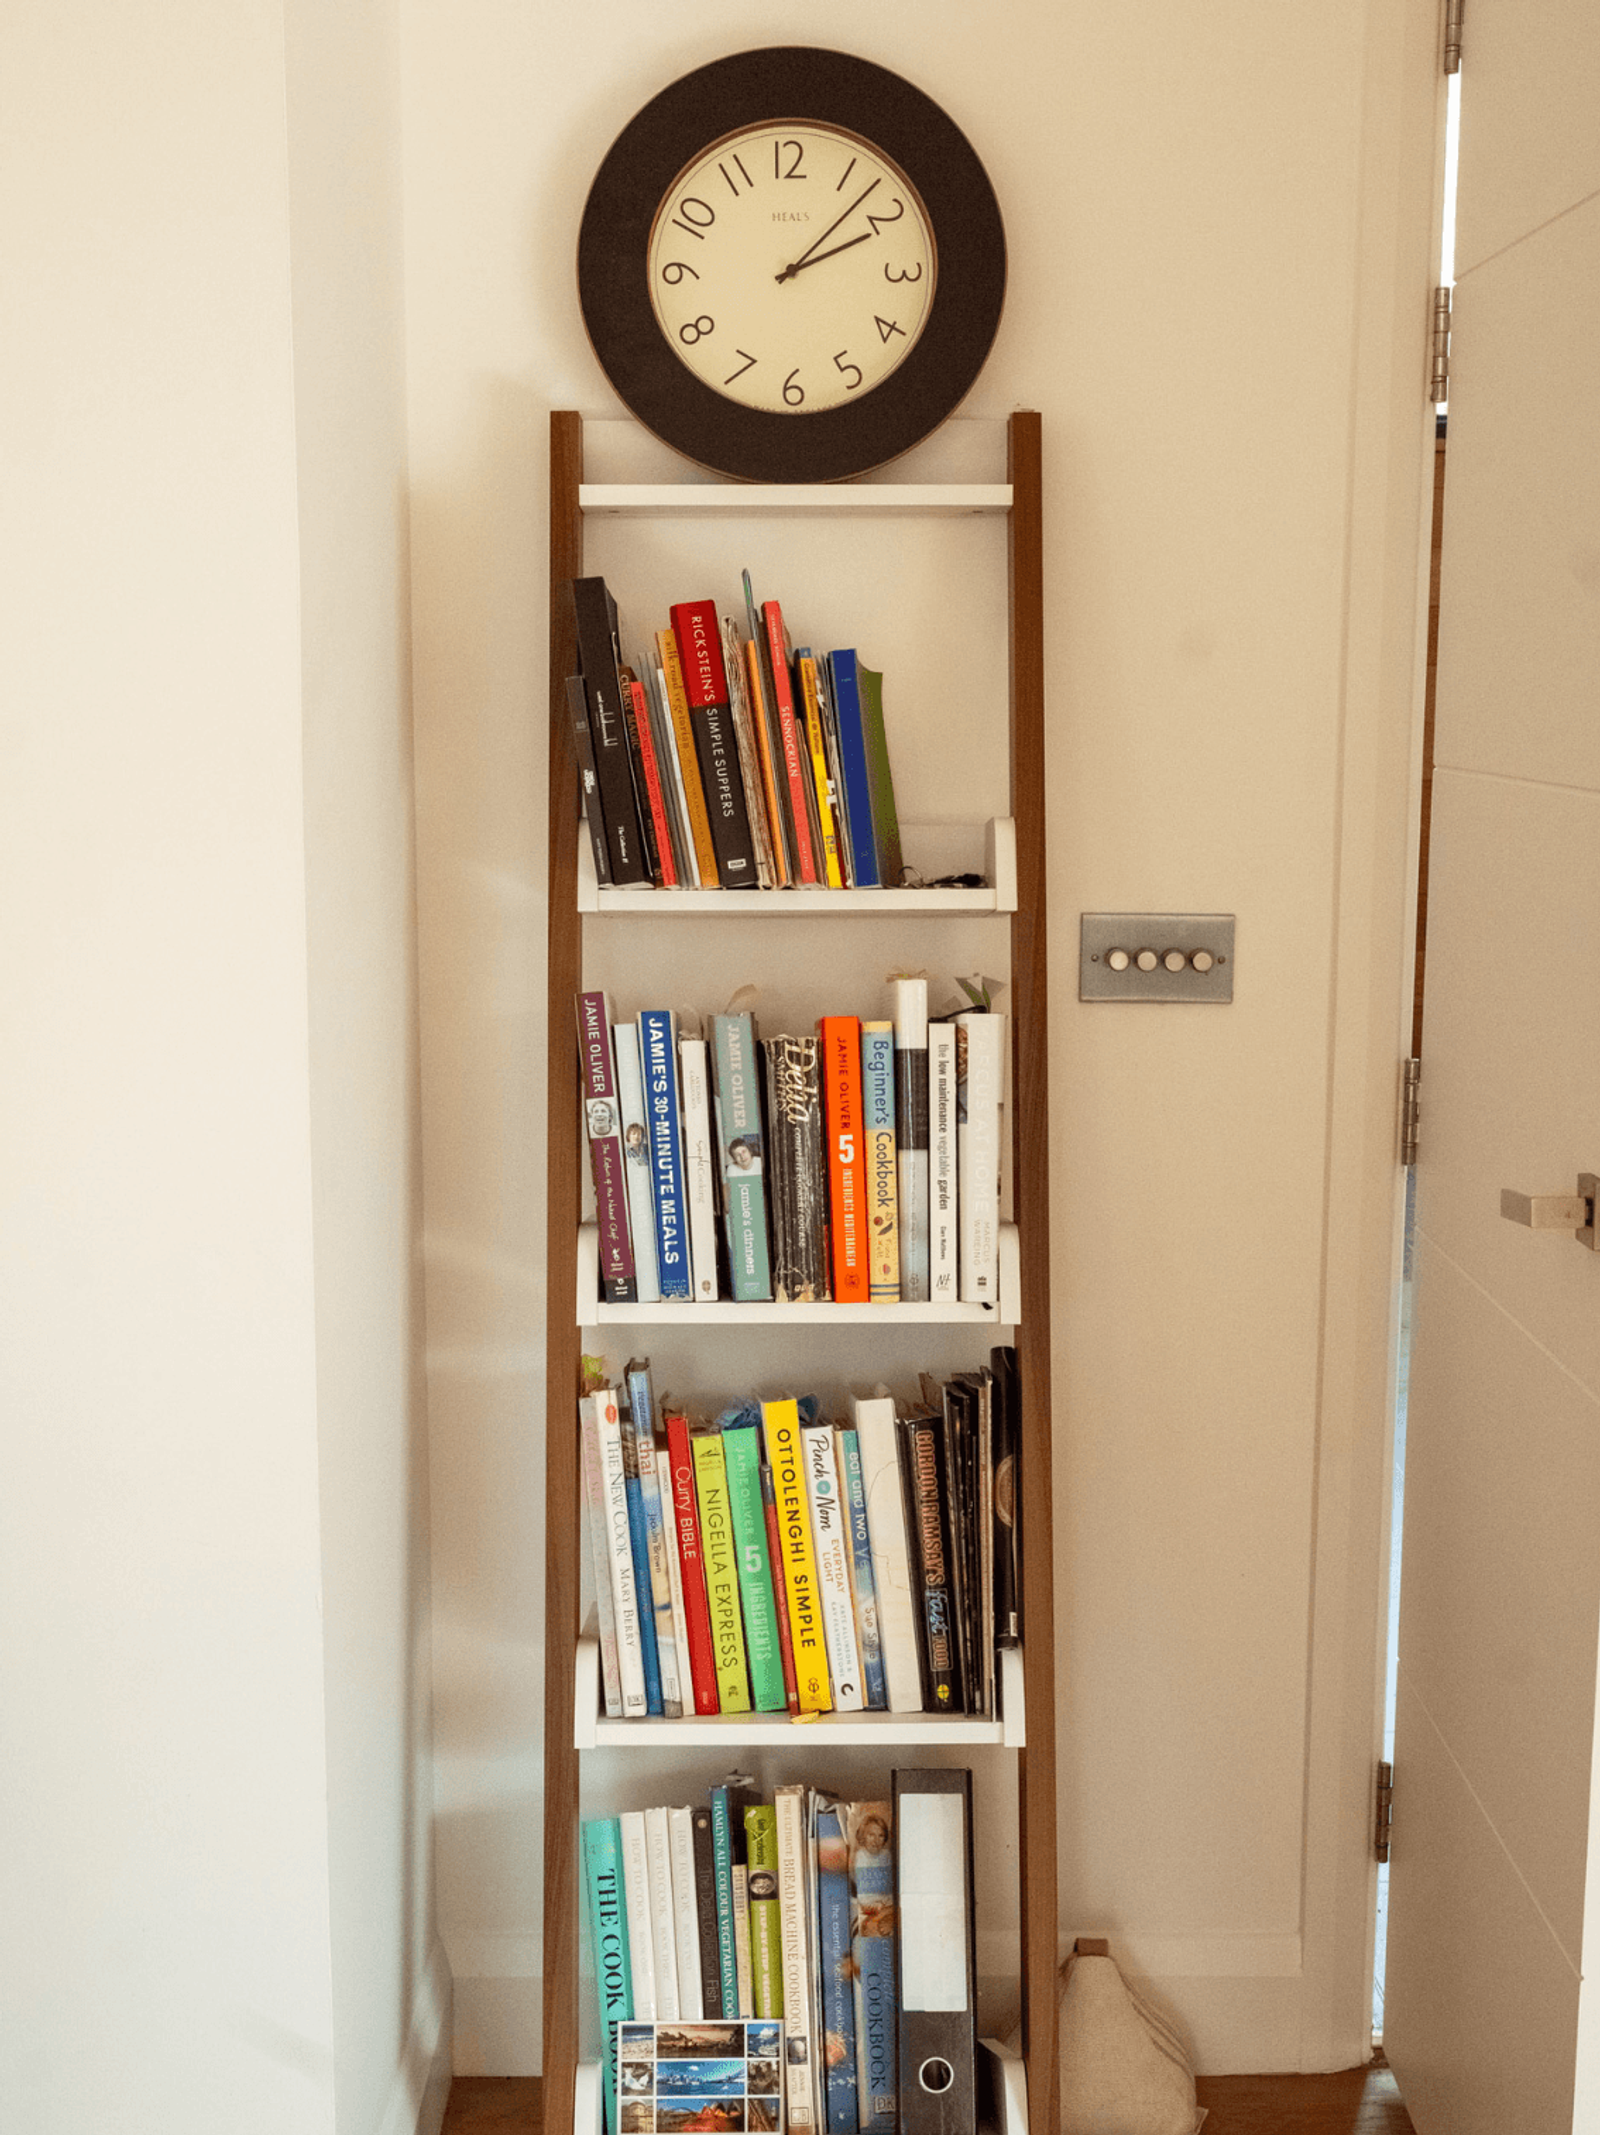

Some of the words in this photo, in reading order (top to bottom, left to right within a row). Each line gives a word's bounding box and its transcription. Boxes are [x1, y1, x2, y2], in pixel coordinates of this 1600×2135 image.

[718, 153, 754, 197] 11
[774, 141, 808, 180] 12
[836, 157, 857, 192] 1
[671, 196, 716, 240] 10
[771, 211, 810, 222] HEAL'S
[866, 198, 905, 236] 2
[662, 261, 700, 285] 9
[884, 262, 922, 284] 3
[679, 314, 715, 345] 8
[873, 314, 907, 344] 4
[723, 349, 758, 386] 7
[833, 350, 863, 390] 5
[782, 368, 805, 407] 6
[690, 614, 707, 647] RICK
[665, 640, 678, 661] silk
[669, 663, 683, 689] road
[696, 649, 716, 702] STEIN'S
[670, 692, 693, 750] vegetarian
[705, 707, 724, 756] SIMPLE
[780, 705, 799, 777] SENNOCKIAN
[714, 758, 734, 818] SUPPERS
[583, 998, 599, 1040] JAMIE
[648, 1017, 667, 1092] JAMIE'S
[726, 1023, 742, 1068] JAMIE
[835, 1035, 848, 1076] JAMIE
[938, 1043, 948, 1057] the
[588, 1043, 605, 1092] OLIVER
[782, 1041, 819, 1124] Delia
[868, 1040, 891, 1124] Beginner's
[938, 1060, 949, 1075] low
[974, 1022, 990, 1110] MARCUS
[729, 1072, 747, 1128] OLIVER
[838, 1082, 850, 1128] OLIVER
[938, 1077, 949, 1132] maintenance
[653, 1096, 675, 1195] 30-MINUTE
[793, 1127, 802, 1172] COMPLETE
[837, 1134, 854, 1163] 5
[974, 1116, 989, 1144] AT
[875, 1131, 893, 1207] Cookbook
[936, 1135, 949, 1178] vegetable
[695, 1167, 708, 1203] Cooking
[841, 1168, 854, 1211] INGREDIENTS
[936, 1179, 948, 1209] garden
[974, 1150, 989, 1212] HOME
[736, 1182, 754, 1226] jamie's
[660, 1199, 679, 1264] MEALS
[796, 1215, 806, 1247] COURSE
[982, 1221, 990, 1262] MARCUS
[741, 1227, 758, 1275] dinners
[606, 1435, 622, 1468] THE
[638, 1439, 657, 1476] thai
[735, 1447, 749, 1485] JAMIE
[808, 1434, 832, 1480] Pinch
[913, 1429, 938, 1499] GORDON
[609, 1471, 626, 1509] NEW
[671, 1465, 693, 1512] Curry
[850, 1481, 864, 1509] and
[740, 1486, 755, 1534] OLIVER
[814, 1494, 838, 1532] Nom
[853, 1512, 867, 1540] two
[612, 1510, 630, 1557] COOK
[680, 1517, 696, 1559] BIBLE
[705, 1488, 728, 1574] NIGELLA
[776, 1427, 805, 1563] OTTOLENGHI
[793, 1574, 816, 1648] SIMPLE
[918, 1501, 945, 1585] RAMSAY'S
[652, 1544, 663, 1573] Brown
[744, 1544, 762, 1572] 5
[821, 1551, 833, 1583] LIGHT
[830, 1538, 845, 1593] EVERYDAY
[619, 1567, 633, 1603] MARY
[622, 1609, 636, 1647] BERRY
[714, 1583, 738, 1668] EXPRESS
[747, 1581, 773, 1660] INGREDIENTS
[830, 1601, 838, 1616] KAY
[839, 1604, 847, 1624] KATE
[863, 1606, 875, 1628] Sue
[925, 1589, 949, 1634] fast
[832, 1618, 844, 1677] FEATHERSTONE
[841, 1626, 851, 1664] ALLINSON
[932, 1635, 950, 1668] FOOD
[712, 1800, 725, 1846] HAMLYN
[782, 1798, 791, 1815] THE
[630, 1837, 641, 1866] HOW
[653, 1833, 665, 1862] HOW
[675, 1829, 687, 1858] HOW
[783, 1817, 793, 1856] ULTIMATE
[632, 1869, 642, 1884] TO
[655, 1864, 667, 1880] TO
[677, 1860, 689, 1875] TO
[698, 1867, 712, 1888] The
[716, 1848, 727, 1869] ALL
[596, 1868, 619, 1926] THE
[678, 1878, 692, 1912] COOK
[716, 1870, 730, 1916] COLOUR
[783, 1858, 796, 1899] BREAD
[633, 1886, 645, 1921] COOK
[656, 1882, 669, 1916] COOK
[700, 1891, 714, 1919] Delia
[832, 1904, 840, 1919] the
[701, 1921, 718, 1975] Collection
[758, 1905, 769, 1970] STEP-BY-STEP
[784, 1902, 799, 1961] MACHINE
[832, 1921, 842, 1959] essential
[601, 1932, 625, 2010] COOK
[719, 1919, 734, 1987] VEGETARIAN
[705, 1978, 720, 2002] Fish
[786, 1963, 802, 2033] COOKBOOK
[834, 1963, 844, 1997] seafood
[866, 1972, 886, 2089] COOKBOOK
